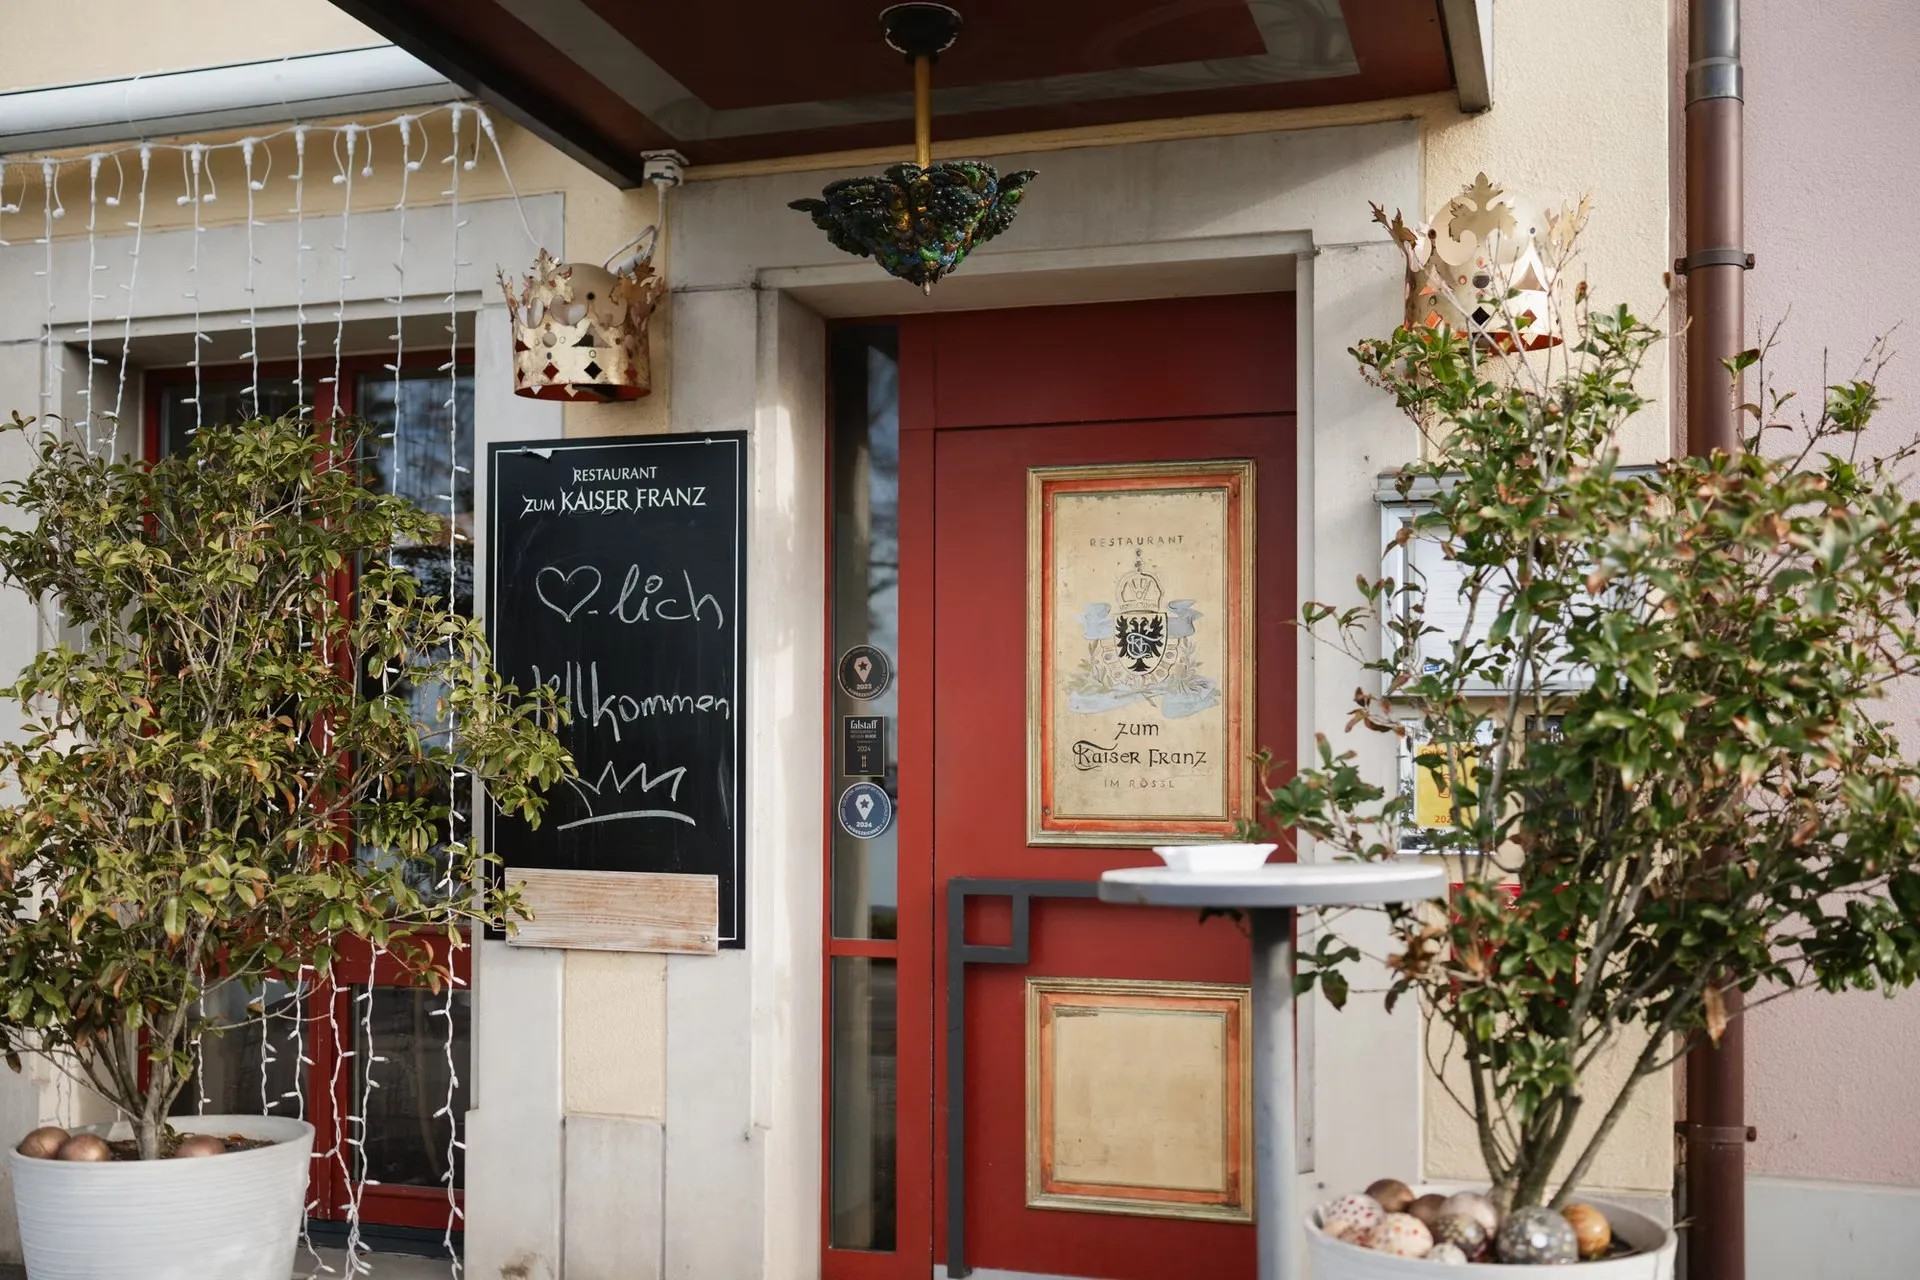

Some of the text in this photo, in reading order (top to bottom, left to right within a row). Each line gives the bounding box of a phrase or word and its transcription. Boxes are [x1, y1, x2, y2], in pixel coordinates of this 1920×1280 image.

[572, 466, 657, 485] RESTAURANT
[519, 486, 707, 520] ZUM KAISER FRANZ
[1089, 535, 1184, 548] RESTAURANT
[850, 720, 878, 730] falstaff
[1104, 777, 1175, 789] IM RÖSSL
